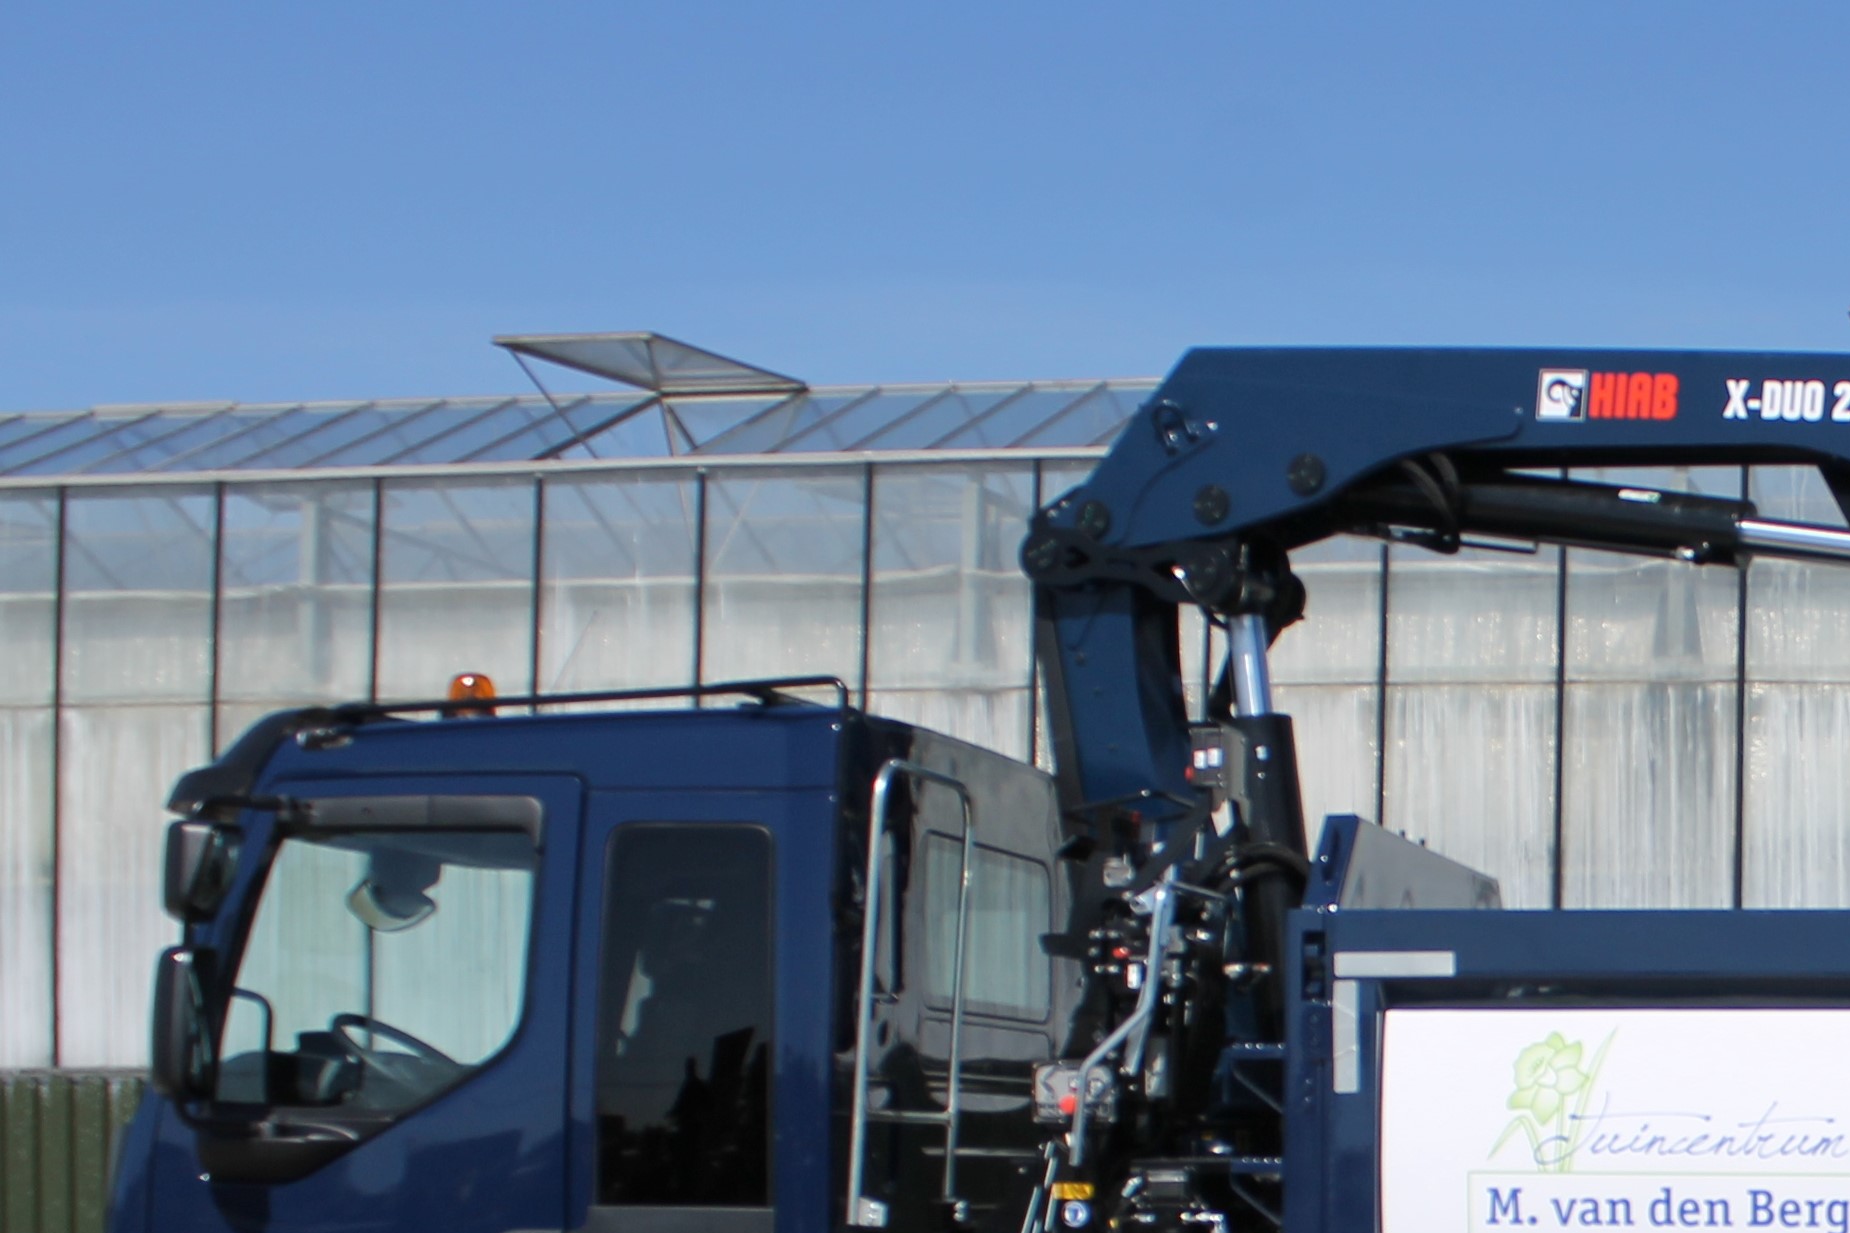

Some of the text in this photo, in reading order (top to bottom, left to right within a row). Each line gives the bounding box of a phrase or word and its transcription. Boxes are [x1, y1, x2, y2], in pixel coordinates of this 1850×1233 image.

[1587, 371, 1680, 420] HIAB
[1722, 378, 1826, 420] X-DUO
[1534, 1092, 1850, 1166] Tuincentrum
[1484, 1185, 1539, 1227] M.
[1550, 1196, 1635, 1227] van
[1647, 1186, 1734, 1228] den
